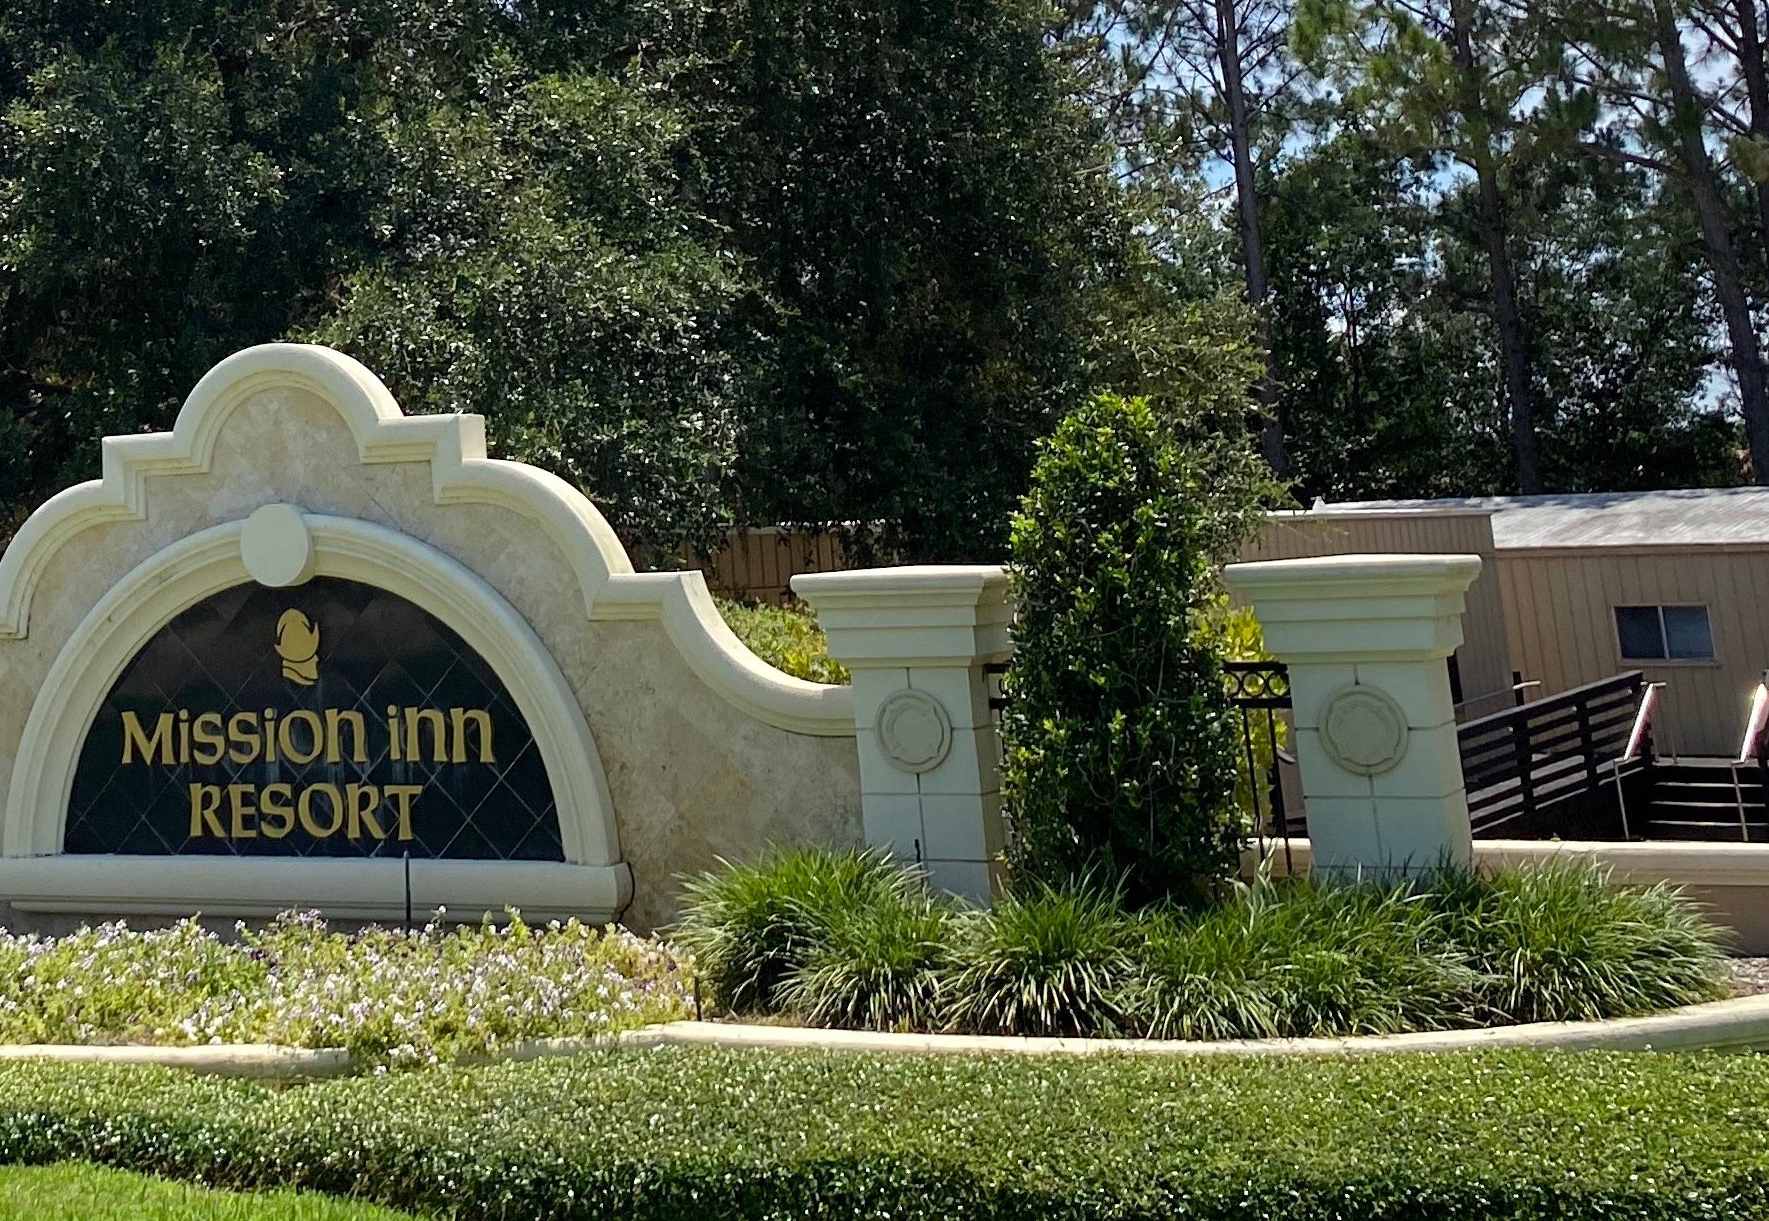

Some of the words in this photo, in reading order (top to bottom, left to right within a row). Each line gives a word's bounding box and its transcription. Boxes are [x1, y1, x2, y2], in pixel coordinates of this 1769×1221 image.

[121, 706, 367, 765] Mission
[386, 704, 496, 764] inn
[189, 782, 424, 841] RESORT
